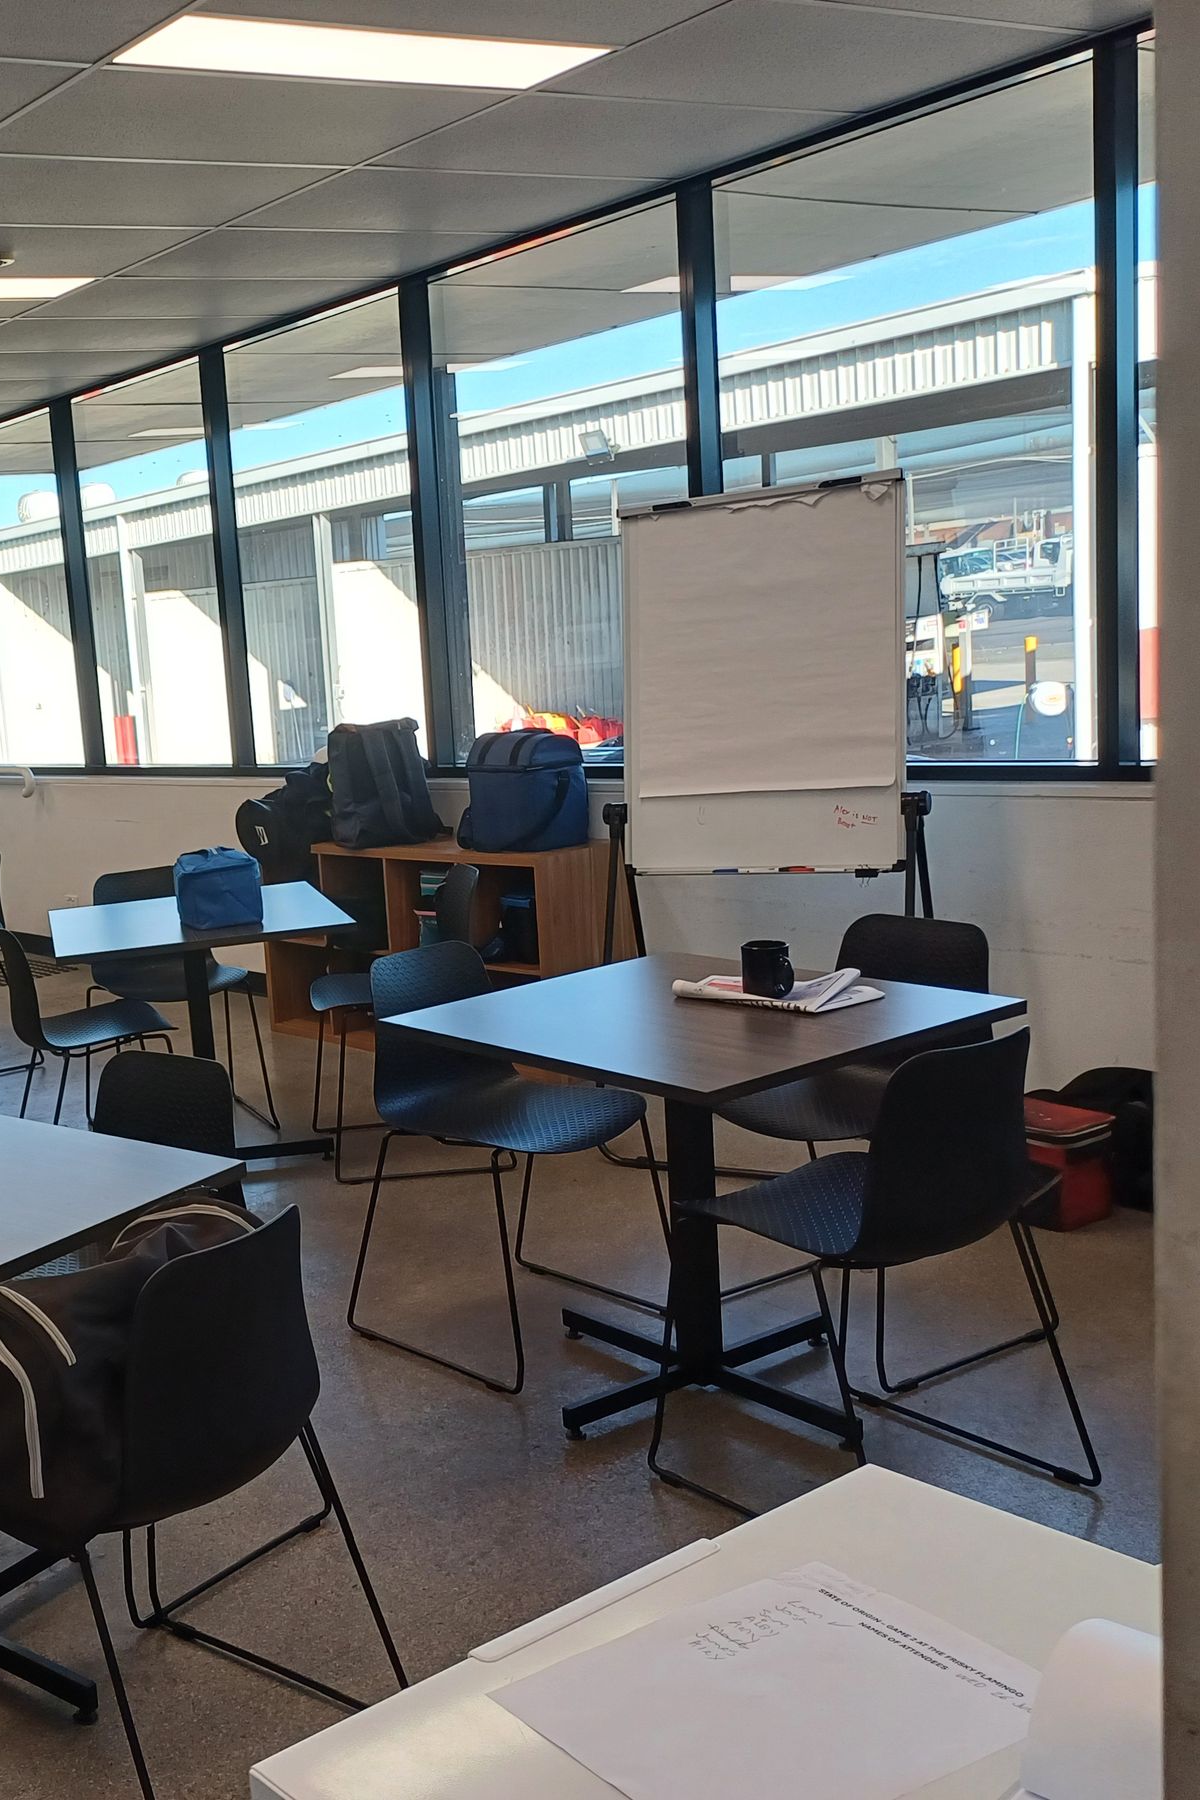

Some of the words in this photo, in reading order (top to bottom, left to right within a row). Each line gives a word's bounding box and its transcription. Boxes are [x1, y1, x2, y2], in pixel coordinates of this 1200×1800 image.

[862, 814, 878, 822] NOT
[818, 1588, 842, 1603] STATE
[852, 1607, 882, 1623] ORIGIN
[886, 1624, 912, 1638] GAME
[928, 1646, 946, 1656] THE
[944, 1655, 977, 1672] FRISKY
[974, 1671, 1024, 1698] FLAMINGO
[858, 1621, 889, 1638] NAMES
[898, 1643, 949, 1670] ATTENDEES
